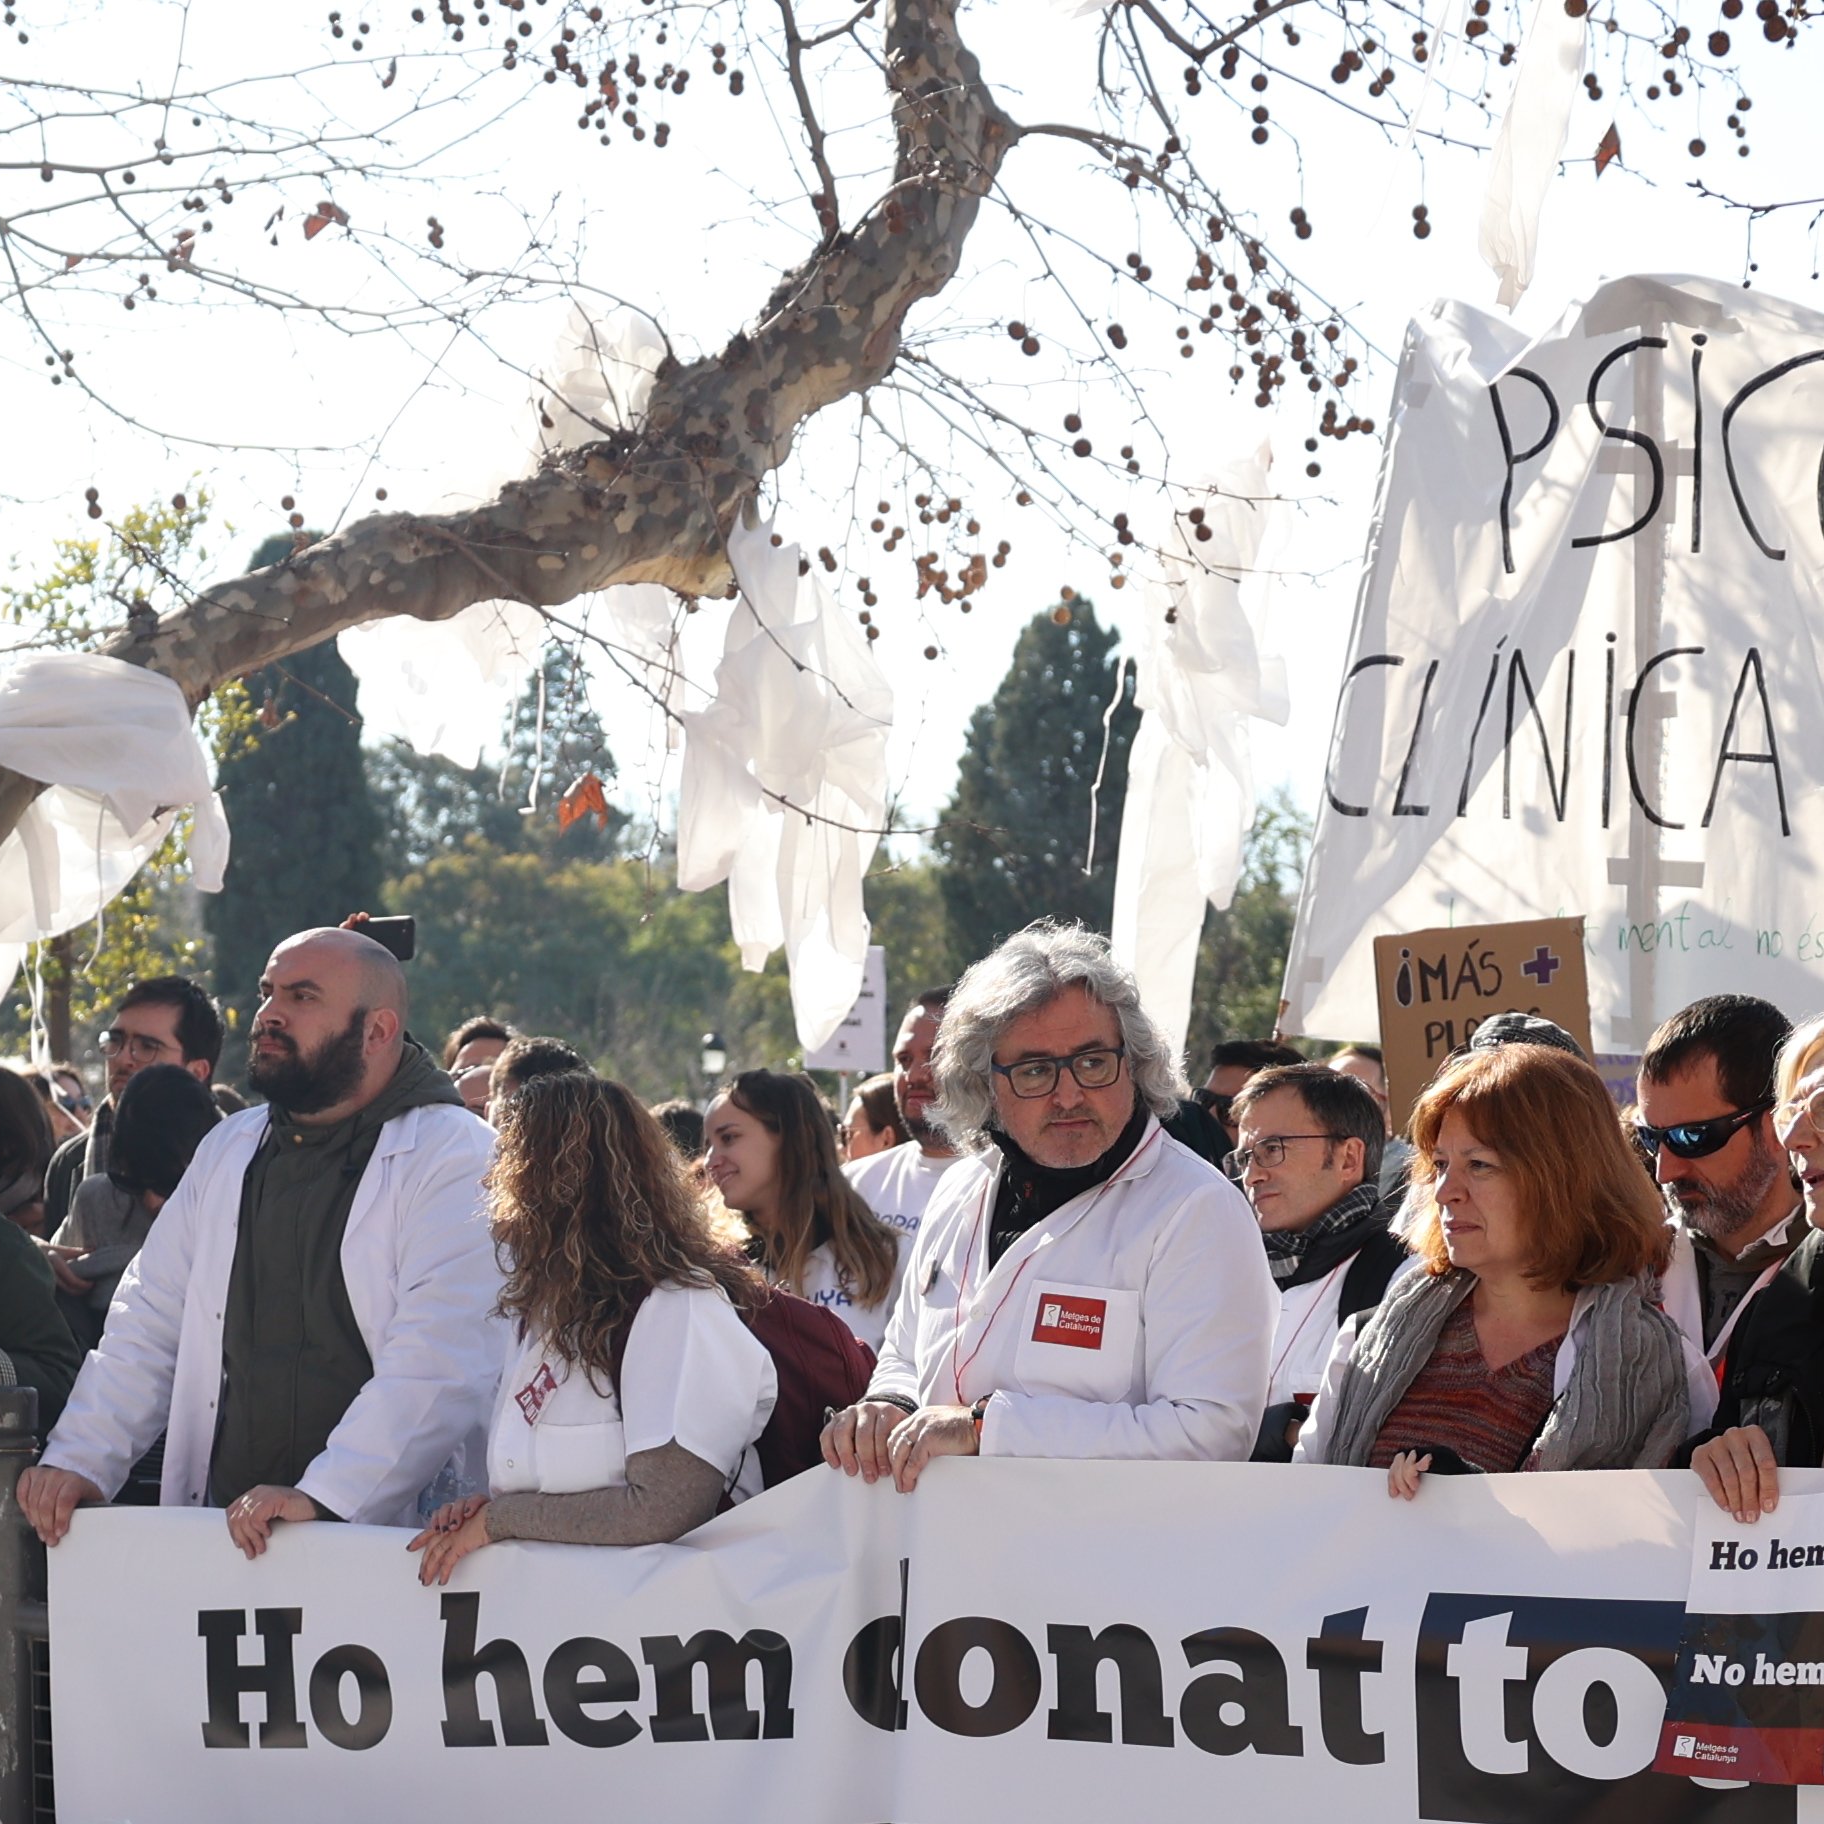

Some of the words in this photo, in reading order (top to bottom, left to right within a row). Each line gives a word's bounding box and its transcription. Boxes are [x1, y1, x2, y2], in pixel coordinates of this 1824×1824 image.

[1060, 1310, 1090, 1323] Metges
[1090, 1315, 1102, 1324] de
[1058, 1319, 1101, 1335] Catalunya
[1709, 1541, 1759, 1571] Ho
[197, 1605, 394, 1752] Ho
[439, 1590, 795, 1750] hem
[842, 1557, 1387, 1768] donat
[1444, 1610, 1753, 1790] to
[1689, 1653, 1747, 1687] No
[1695, 1742, 1727, 1754] Metges
[1727, 1745, 1739, 1754] de
[1694, 1751, 1737, 1764] Catalunya
